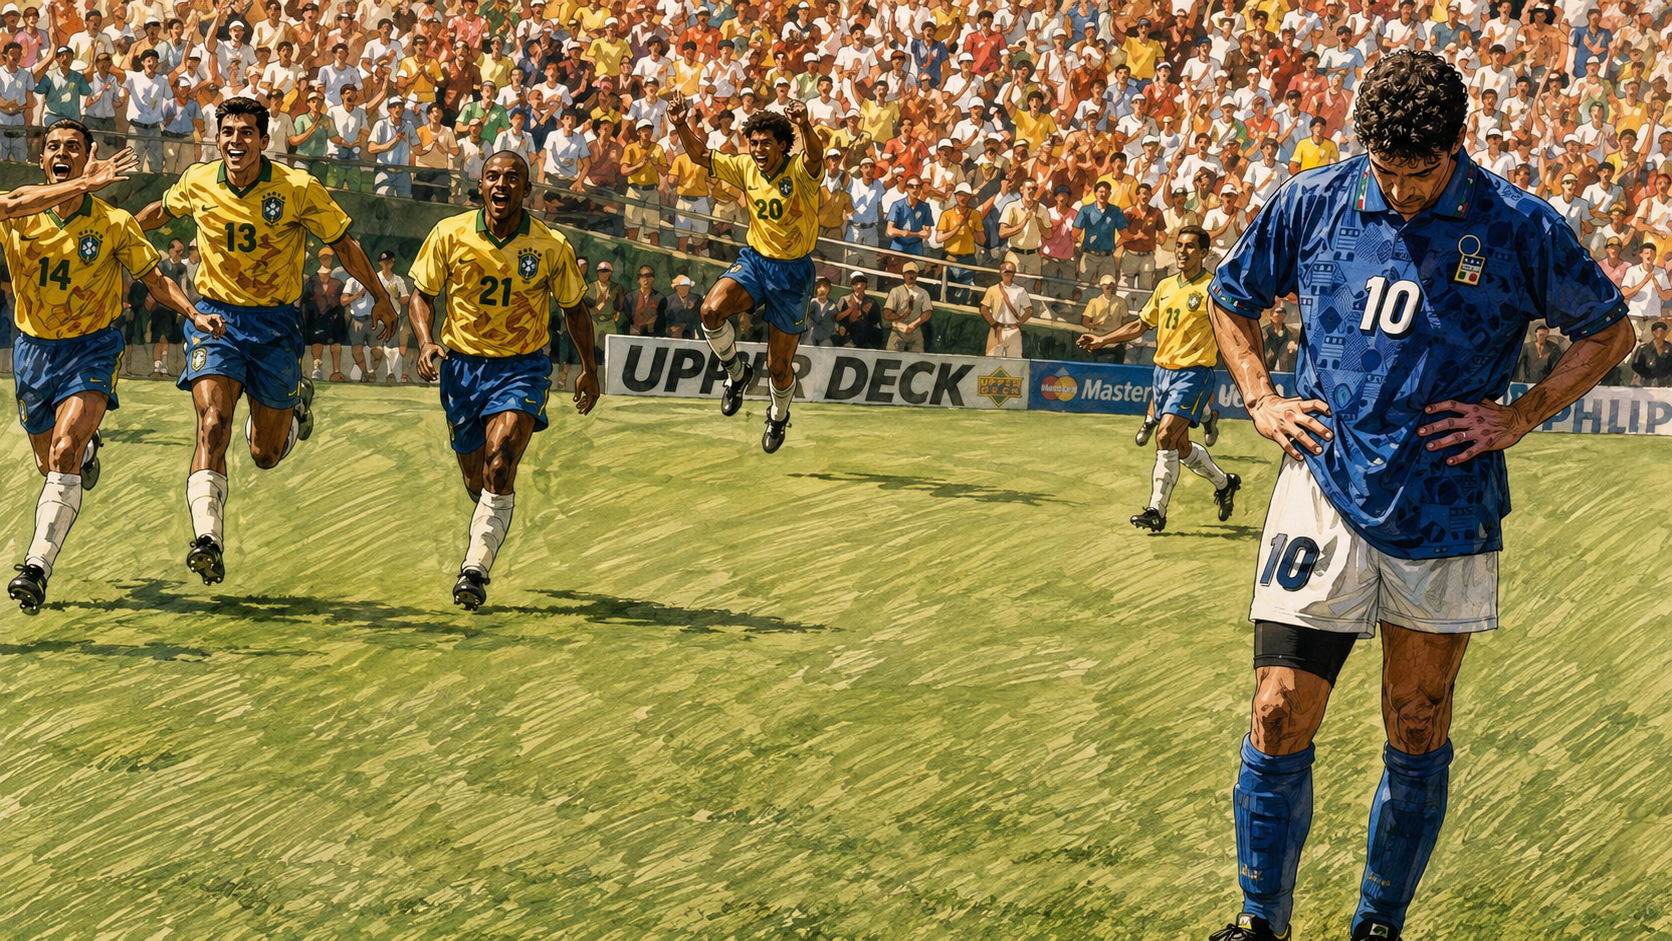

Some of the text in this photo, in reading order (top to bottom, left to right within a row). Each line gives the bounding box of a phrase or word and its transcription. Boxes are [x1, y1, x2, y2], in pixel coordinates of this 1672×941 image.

[754, 198, 783, 220] 20
[225, 222, 257, 252] 13
[38, 256, 72, 291] 14
[479, 275, 513, 307] 21
[1359, 275, 1422, 339] 10
[824, 355, 976, 407] DECK
[1080, 378, 1152, 403] Master
[1259, 532, 1321, 592] 10
